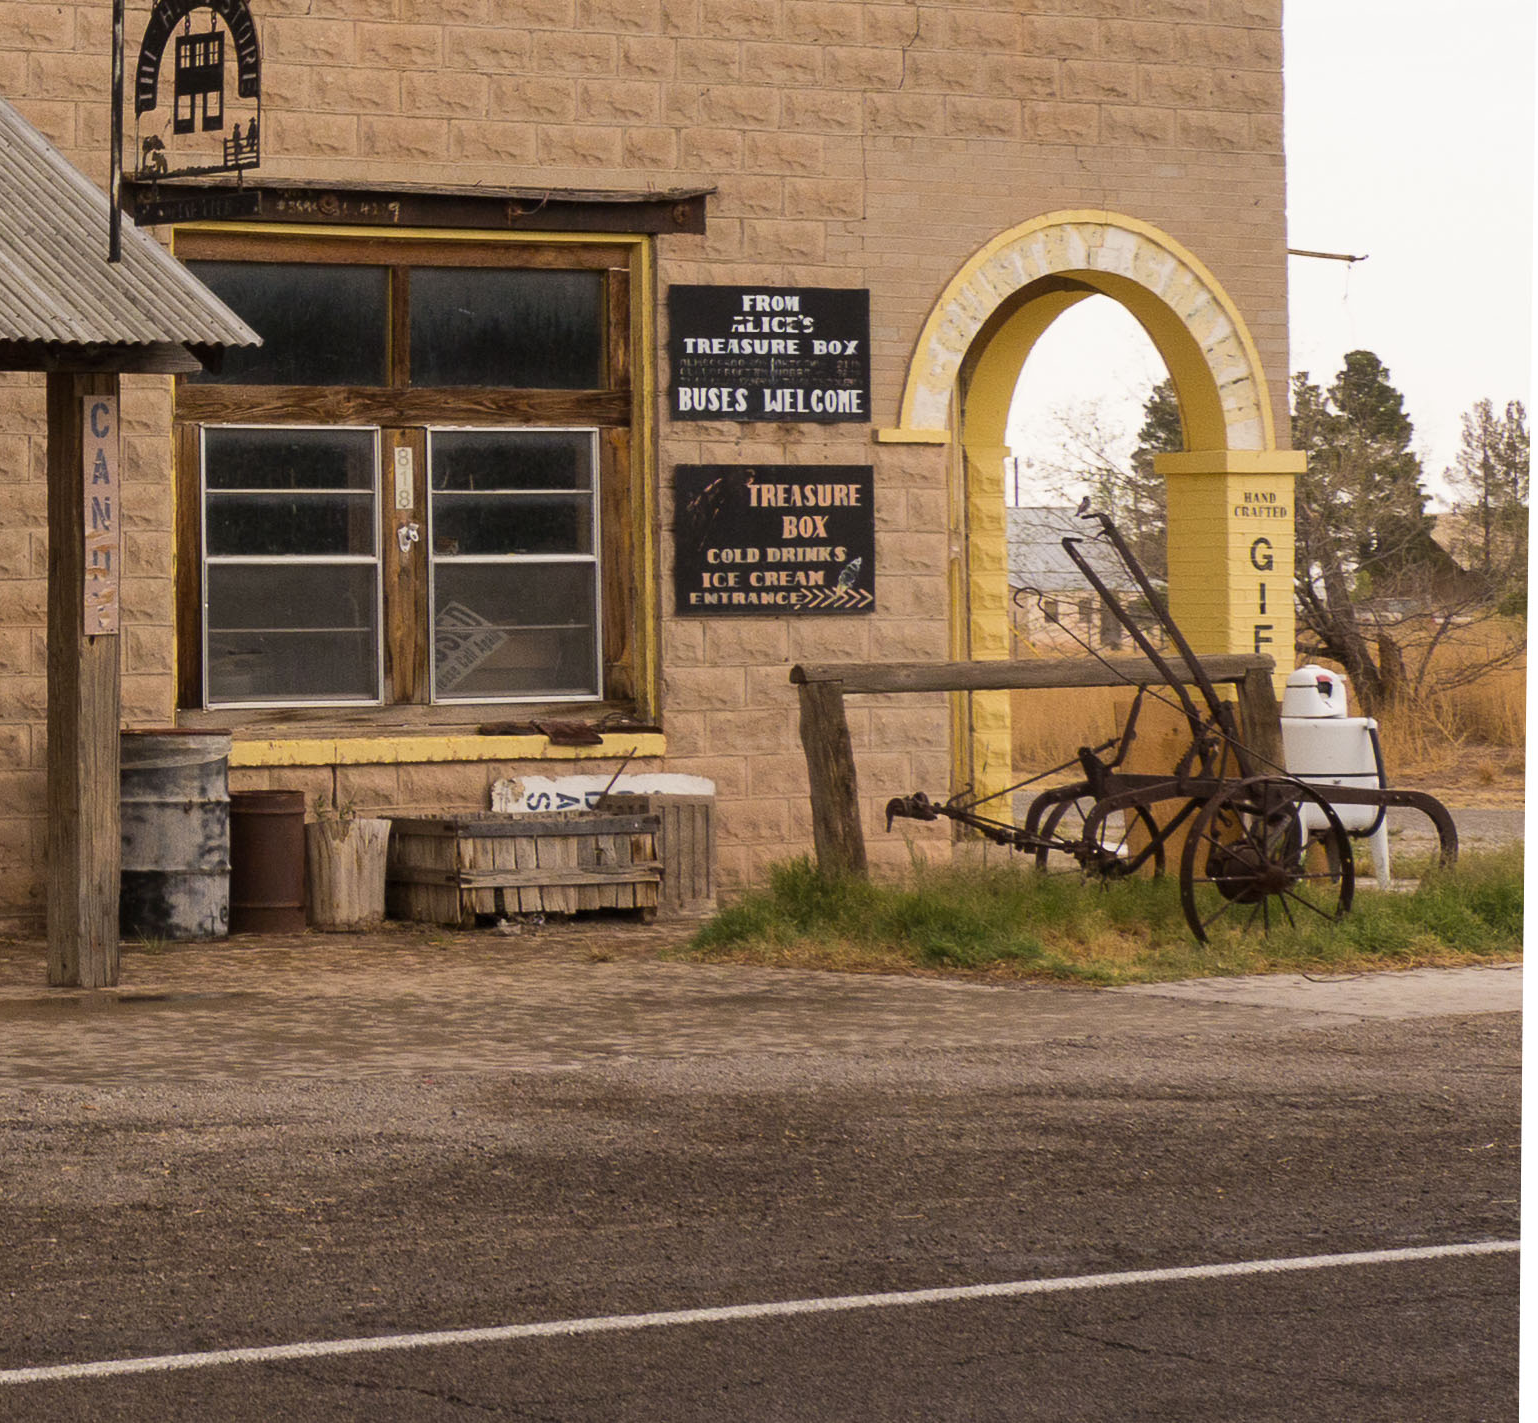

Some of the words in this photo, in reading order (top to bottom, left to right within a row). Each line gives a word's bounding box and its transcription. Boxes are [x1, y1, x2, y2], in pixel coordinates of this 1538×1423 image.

[742, 295, 800, 312] FROM
[731, 314, 814, 333] ALICE'S
[683, 338, 800, 354] TREASURE
[813, 339, 860, 356] BOX
[678, 387, 748, 412] BUSES
[764, 389, 864, 414] WELCOME
[398, 448, 410, 507] 818
[748, 484, 862, 507] TREASURE
[1244, 492, 1277, 504] HAND
[1234, 505, 1288, 519] CRAFTED
[781, 515, 830, 539] BOX
[707, 547, 760, 564] COLD
[766, 546, 848, 563] DRINKS
[701, 572, 741, 588] ICE
[750, 571, 825, 587] CREAM
[689, 592, 805, 606] ENTRANCE
